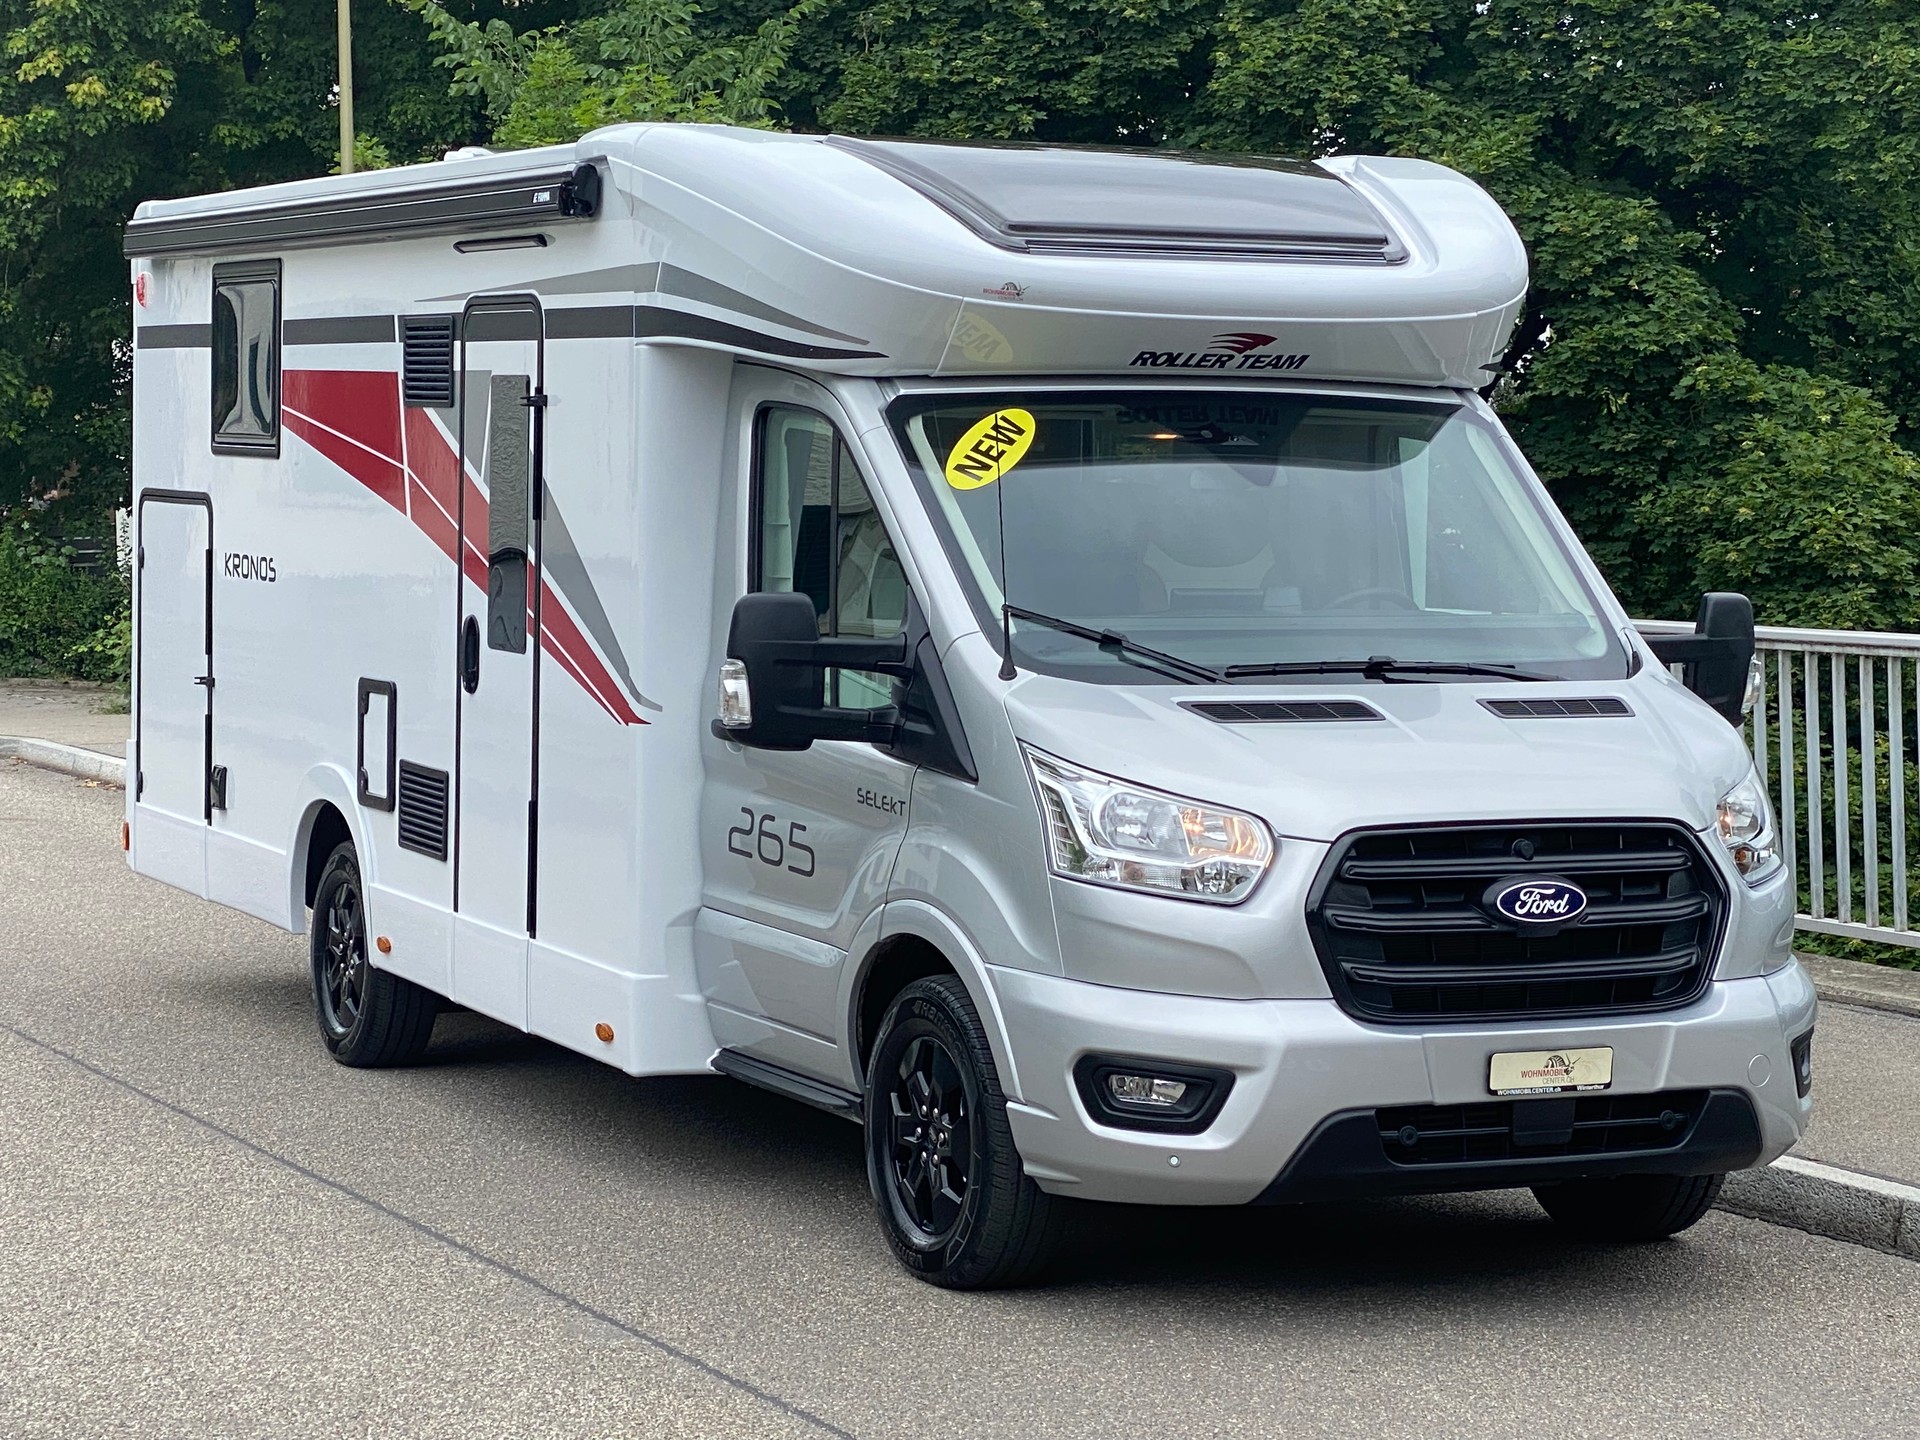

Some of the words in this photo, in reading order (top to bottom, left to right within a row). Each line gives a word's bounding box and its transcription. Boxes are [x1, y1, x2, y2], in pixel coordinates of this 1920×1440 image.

[1129, 350, 1235, 369] ROLLER
[1235, 354, 1310, 370] TEAM
[952, 415, 1026, 482] NEW
[224, 552, 277, 582] KRONOS
[857, 787, 906, 816] SELEKT
[728, 806, 815, 878] 265
[1514, 887, 1570, 914] Ford
[1520, 1066, 1566, 1078] WOHNMOBIL
